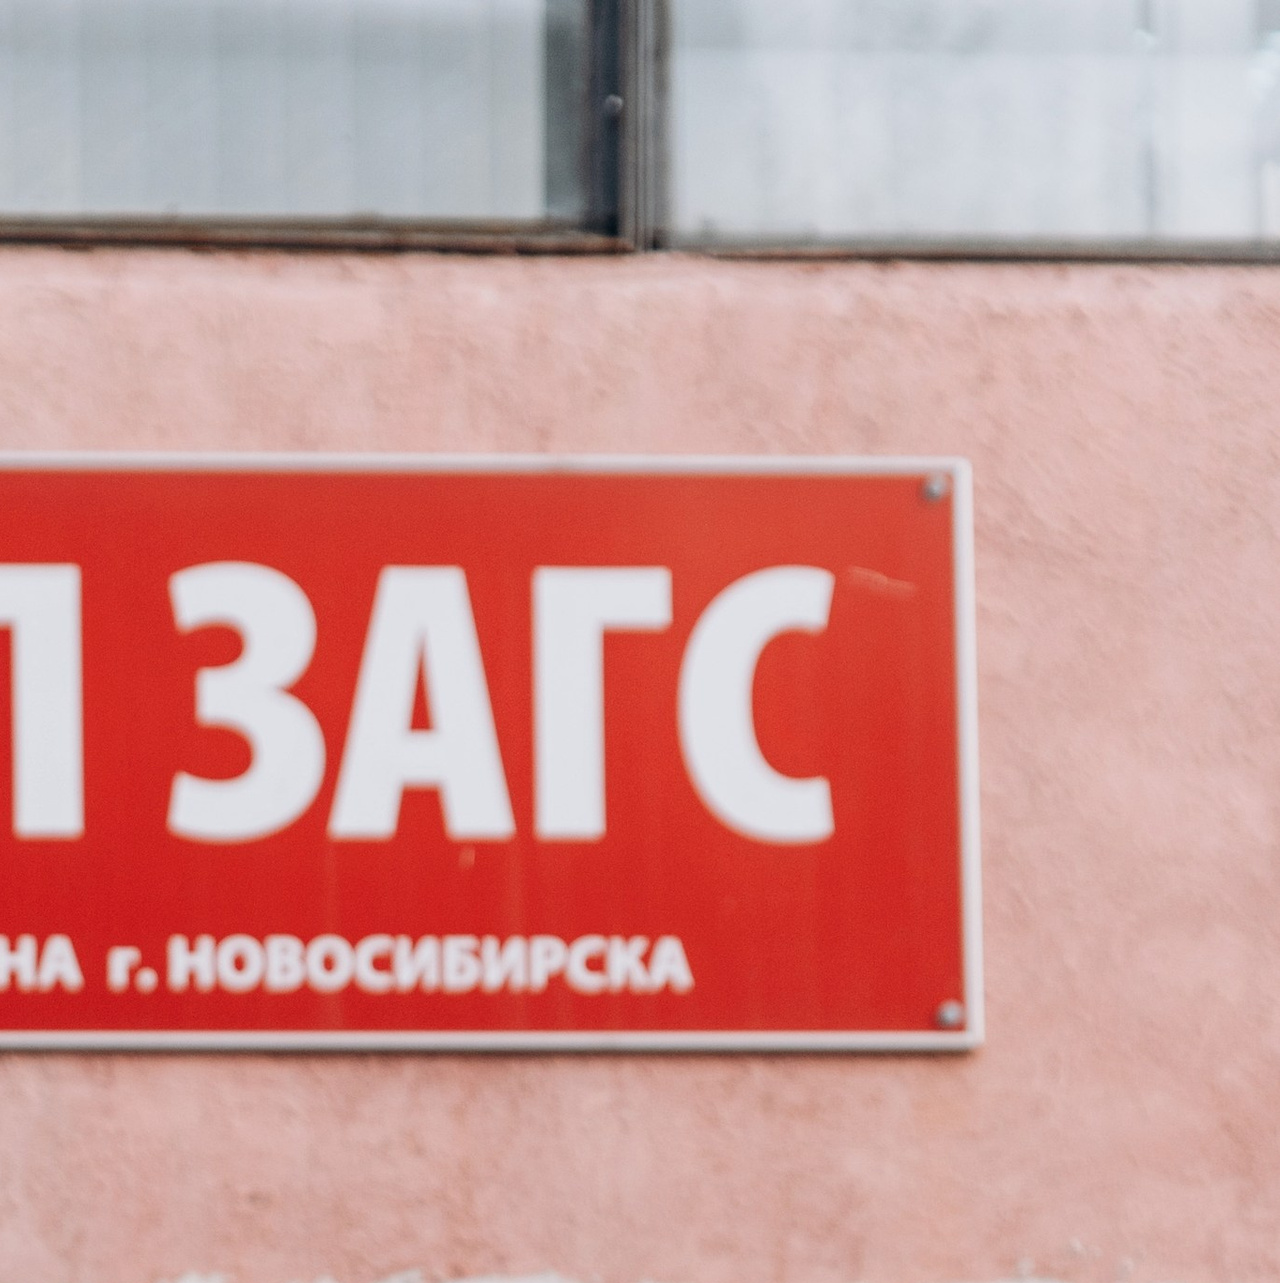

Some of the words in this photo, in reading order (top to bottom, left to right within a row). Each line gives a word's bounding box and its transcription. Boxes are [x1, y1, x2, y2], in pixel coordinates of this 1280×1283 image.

[167, 562, 835, 843] ЗАГС
[107, 946, 158, 989] г.
[167, 934, 694, 991] НОВОСИБИРСКА
